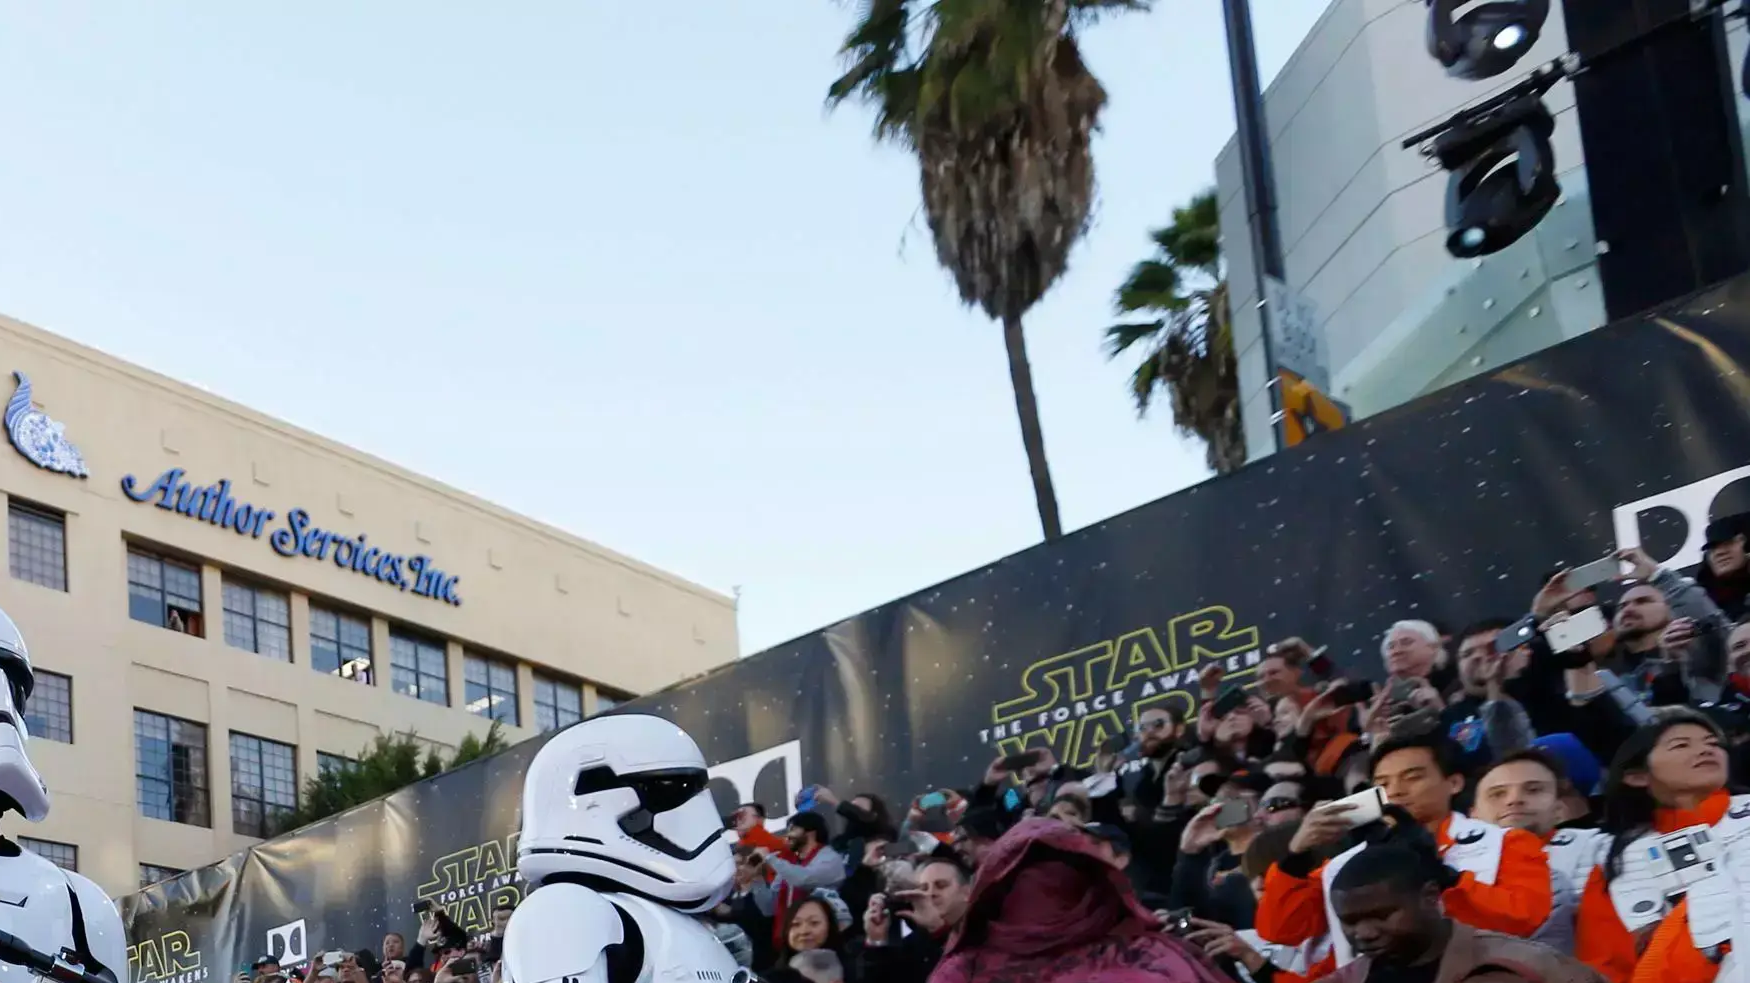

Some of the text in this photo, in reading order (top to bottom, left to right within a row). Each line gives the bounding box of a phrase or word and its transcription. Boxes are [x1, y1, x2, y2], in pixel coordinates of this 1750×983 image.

[120, 466, 276, 540] Author
[993, 605, 1259, 724] STAR
[979, 720, 1023, 744] THE
[1038, 690, 1125, 727] FORCE
[440, 882, 485, 904] FORCE
